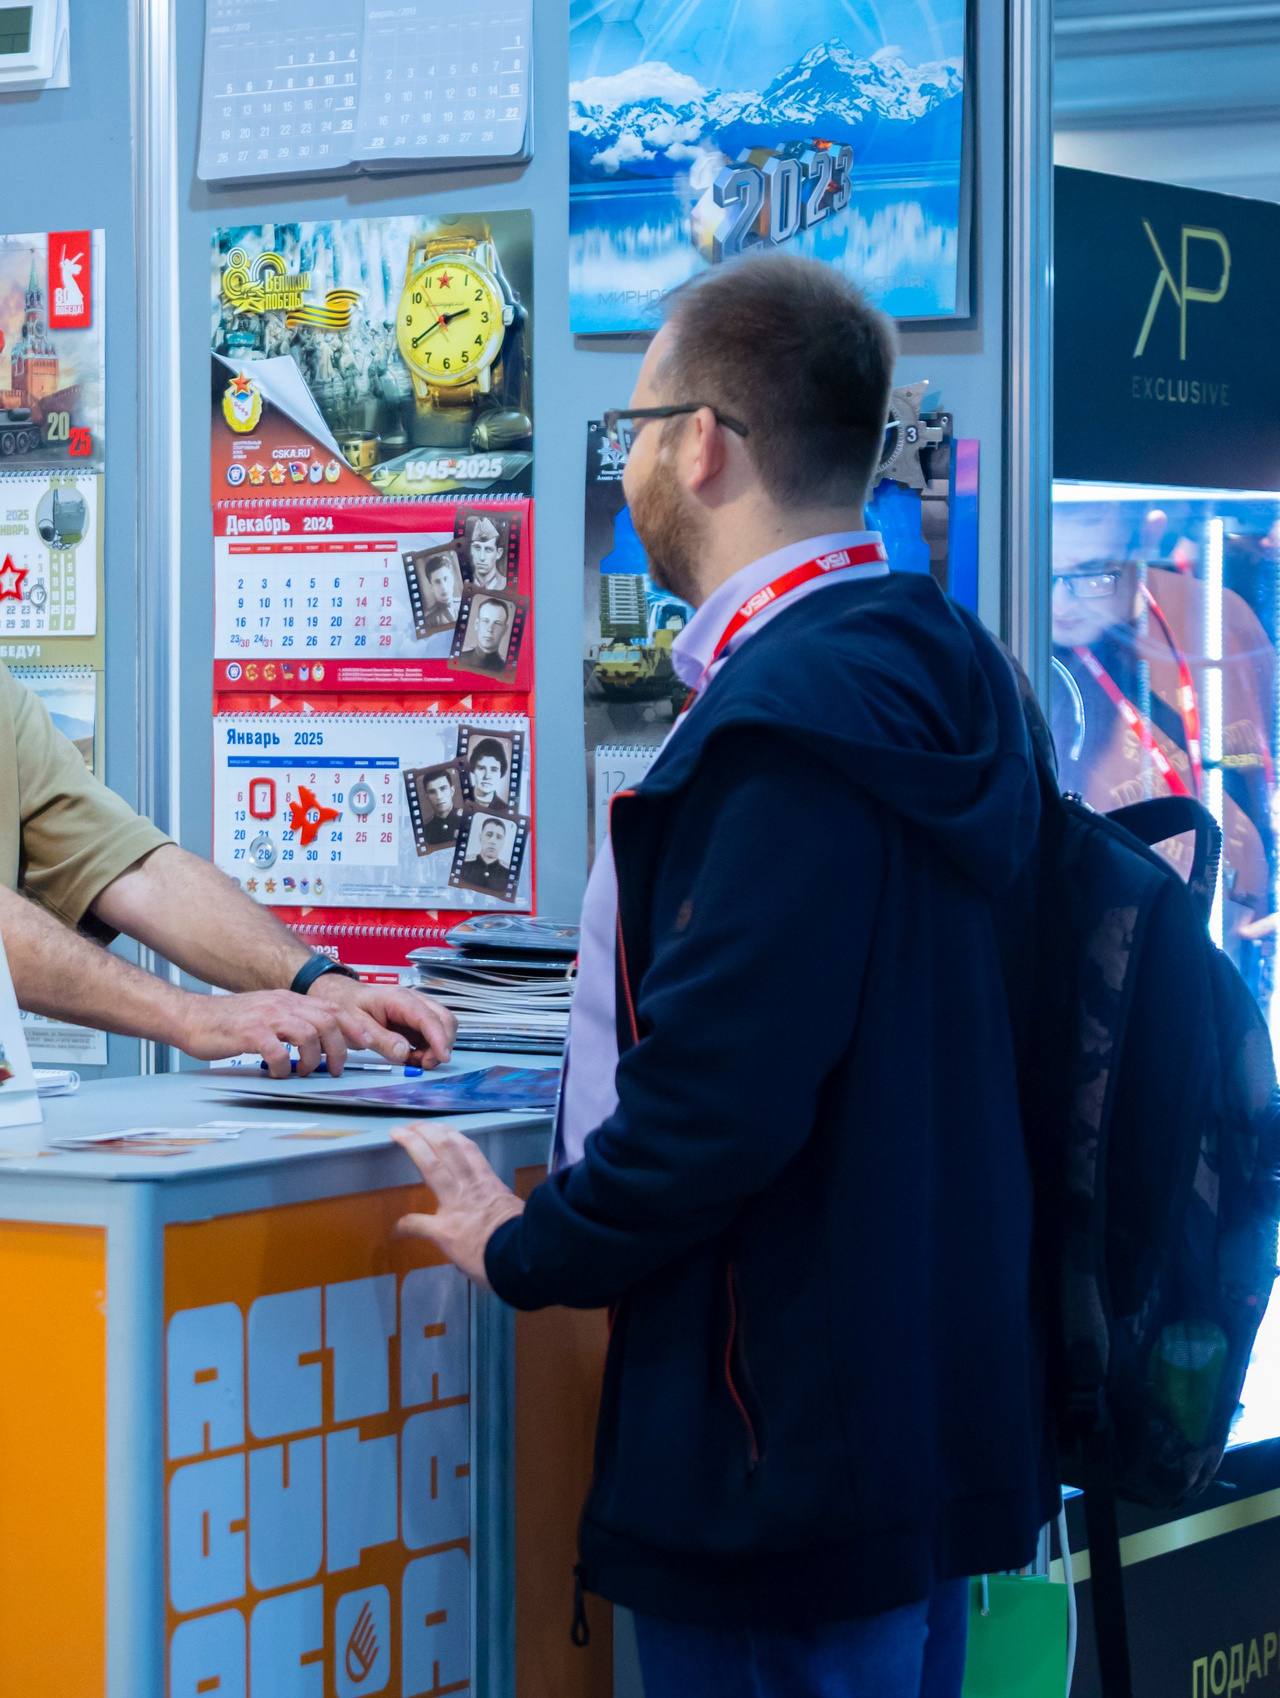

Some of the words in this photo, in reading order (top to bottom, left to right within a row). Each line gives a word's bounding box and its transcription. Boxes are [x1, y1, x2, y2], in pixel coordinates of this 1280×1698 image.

[713, 144, 854, 264] 2023
[412, 292, 422, 304] 10
[475, 290, 483, 301] 2
[481, 312, 489, 323] 3
[1132, 376, 1229, 405] EXCLUSIVE
[907, 427, 917, 442] 3
[272, 449, 311, 459] CSKA.RU
[405, 458, 503, 480] 1945-2025
[6, 510, 29, 521] 2025
[226, 515, 290, 535] Декабрь
[303, 517, 333, 531] 2024
[384, 558, 388, 568] 1
[238, 579, 243, 589] 2
[262, 579, 267, 588] 3
[286, 578, 291, 588] 4
[310, 578, 315, 588] 5
[334, 578, 340, 588] 6
[359, 577, 364, 587] 7
[383, 577, 388, 587] 8
[238, 598, 243, 608] 9
[260, 598, 270, 608] 10
[284, 598, 293, 607] 11
[307, 598, 318, 607] 12
[332, 597, 342, 607] 13
[356, 597, 367, 607] 14
[381, 597, 392, 607] 15
[235, 617, 246, 627] 16
[259, 617, 270, 627] 17
[283, 617, 294, 627] 18
[307, 617, 318, 627] 19
[331, 617, 342, 626] 20
[355, 616, 366, 626] 21
[380, 616, 392, 626] 22
[282, 636, 293, 646] 25
[306, 636, 317, 646] 26
[331, 636, 342, 646] 27
[355, 636, 366, 646] 28
[380, 635, 391, 646] 29
[227, 728, 280, 748] Январь
[294, 732, 323, 745] 2025
[238, 792, 243, 801] 6
[262, 792, 267, 802] 7
[286, 793, 291, 802] 8
[332, 793, 343, 803] 10
[357, 793, 367, 803] 11
[382, 794, 392, 803] 12
[234, 849, 245, 859] 27
[258, 850, 270, 859] 28
[282, 850, 294, 860] 29
[306, 850, 318, 860] 30
[331, 851, 341, 861] 31
[1193, 1632, 1277, 1698] ПОДАР
